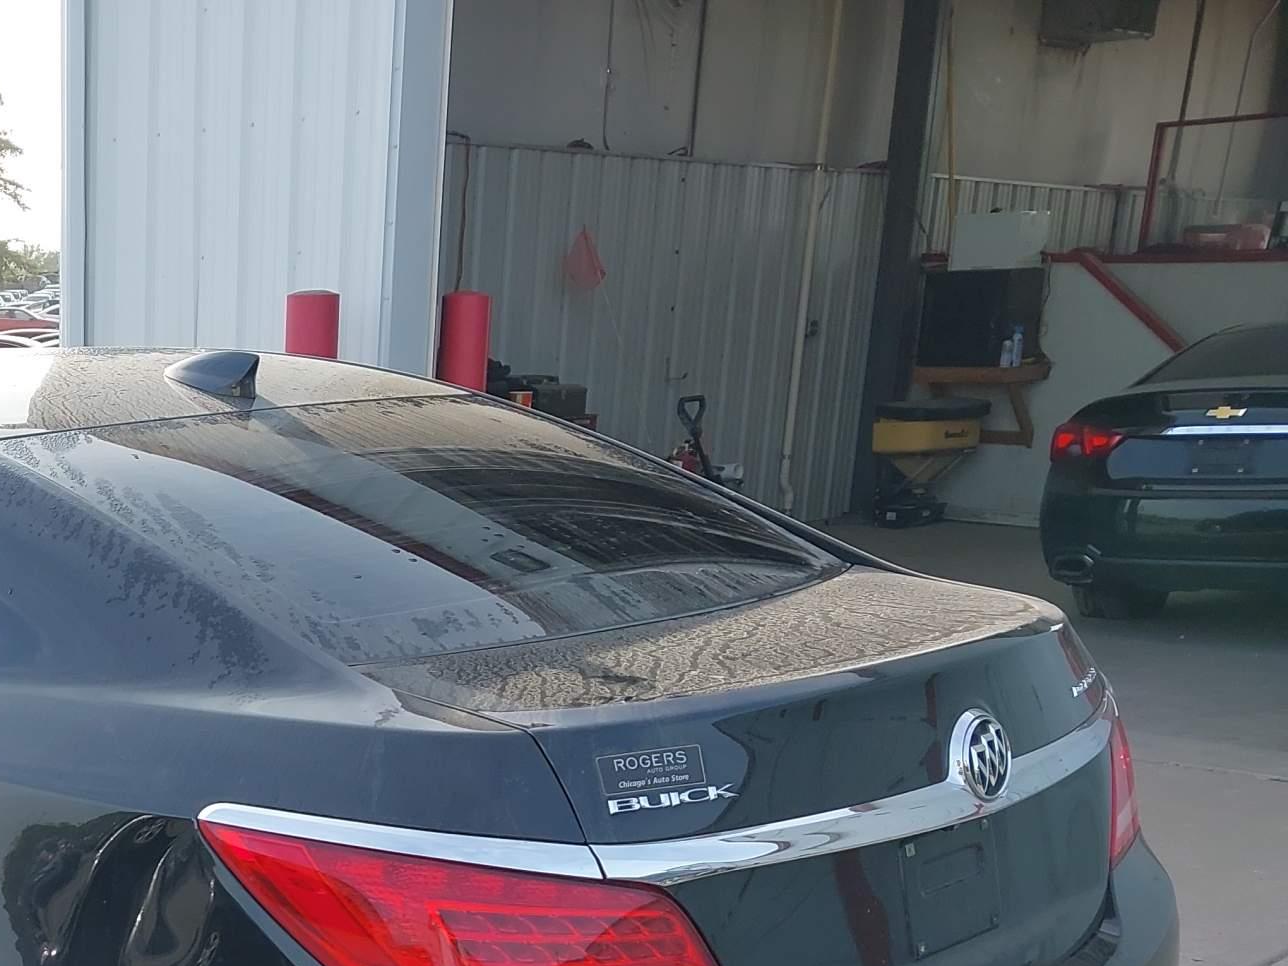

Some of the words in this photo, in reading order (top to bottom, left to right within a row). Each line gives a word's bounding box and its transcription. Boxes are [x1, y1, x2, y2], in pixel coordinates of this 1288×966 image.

[613, 750, 688, 772] ROGERS
[665, 764, 688, 772] GROUP
[618, 777, 652, 789] Chicago's
[653, 775, 670, 784] Auto
[671, 774, 690, 782] Store
[607, 783, 740, 815] BUICK
